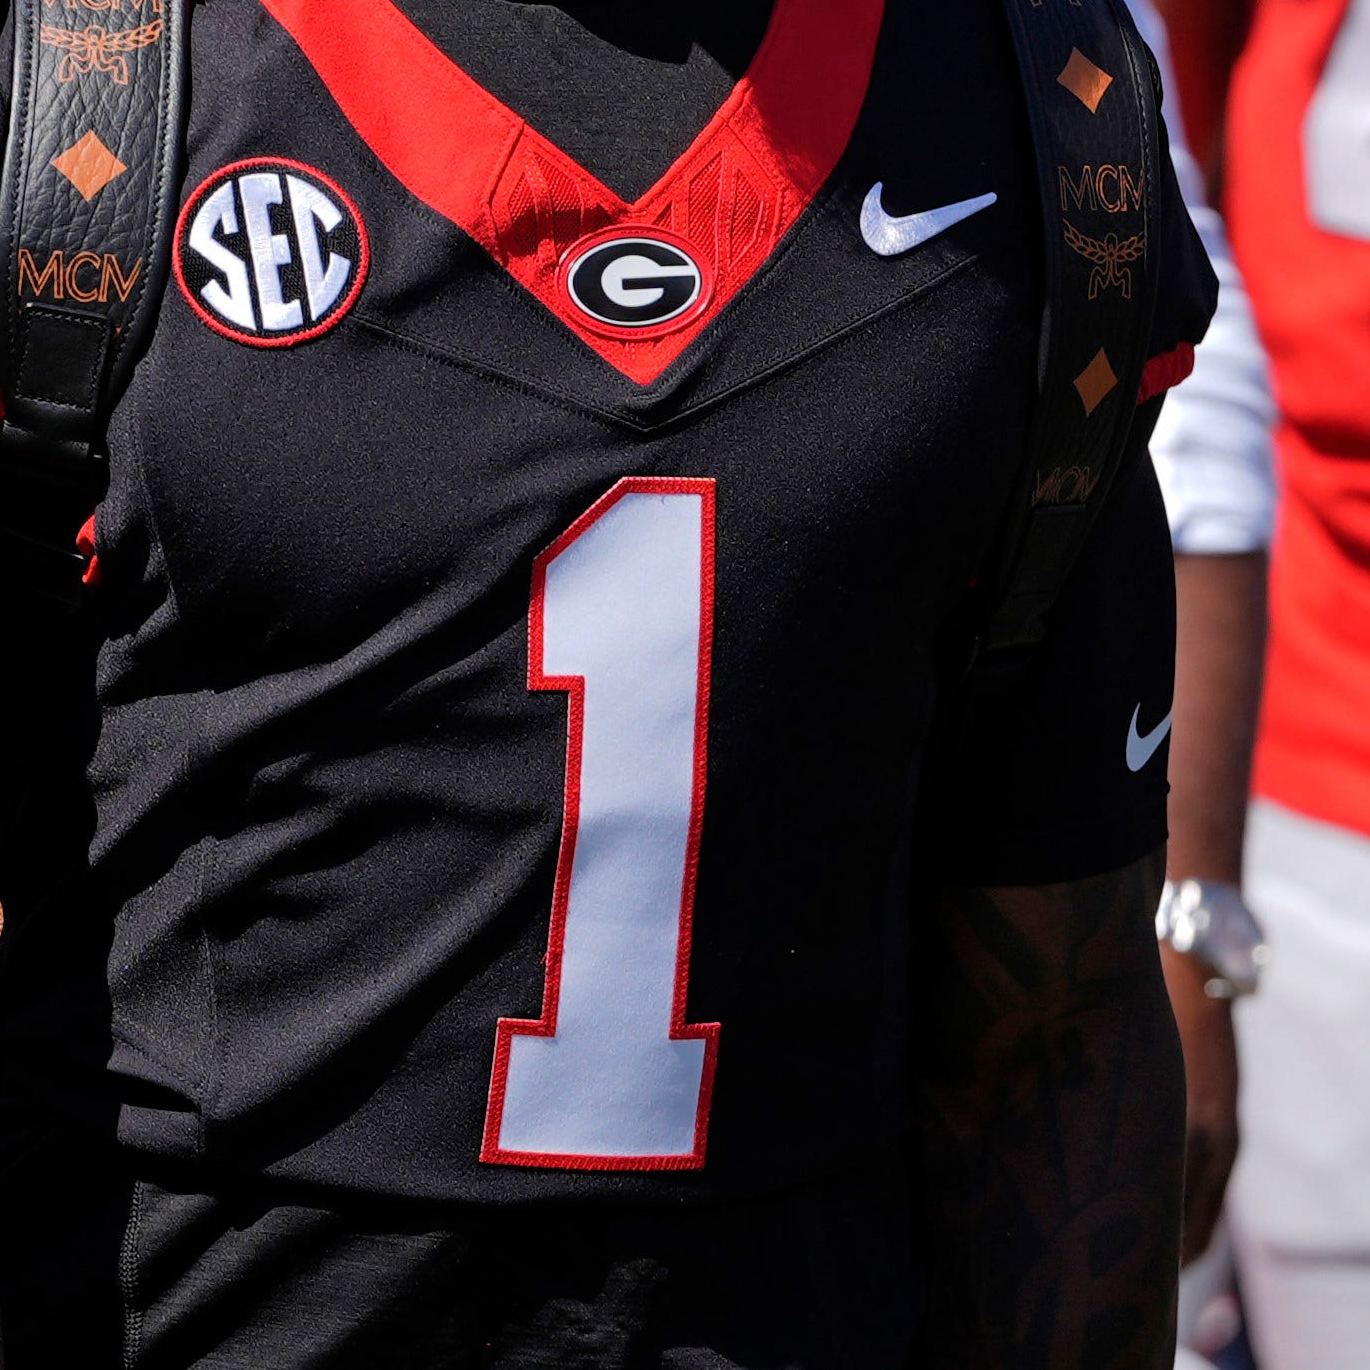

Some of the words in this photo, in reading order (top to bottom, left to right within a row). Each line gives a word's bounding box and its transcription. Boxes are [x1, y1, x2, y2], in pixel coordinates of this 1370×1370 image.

[188, 171, 352, 333] SEC
[570, 240, 698, 324] G
[479, 476, 722, 1170] 1
